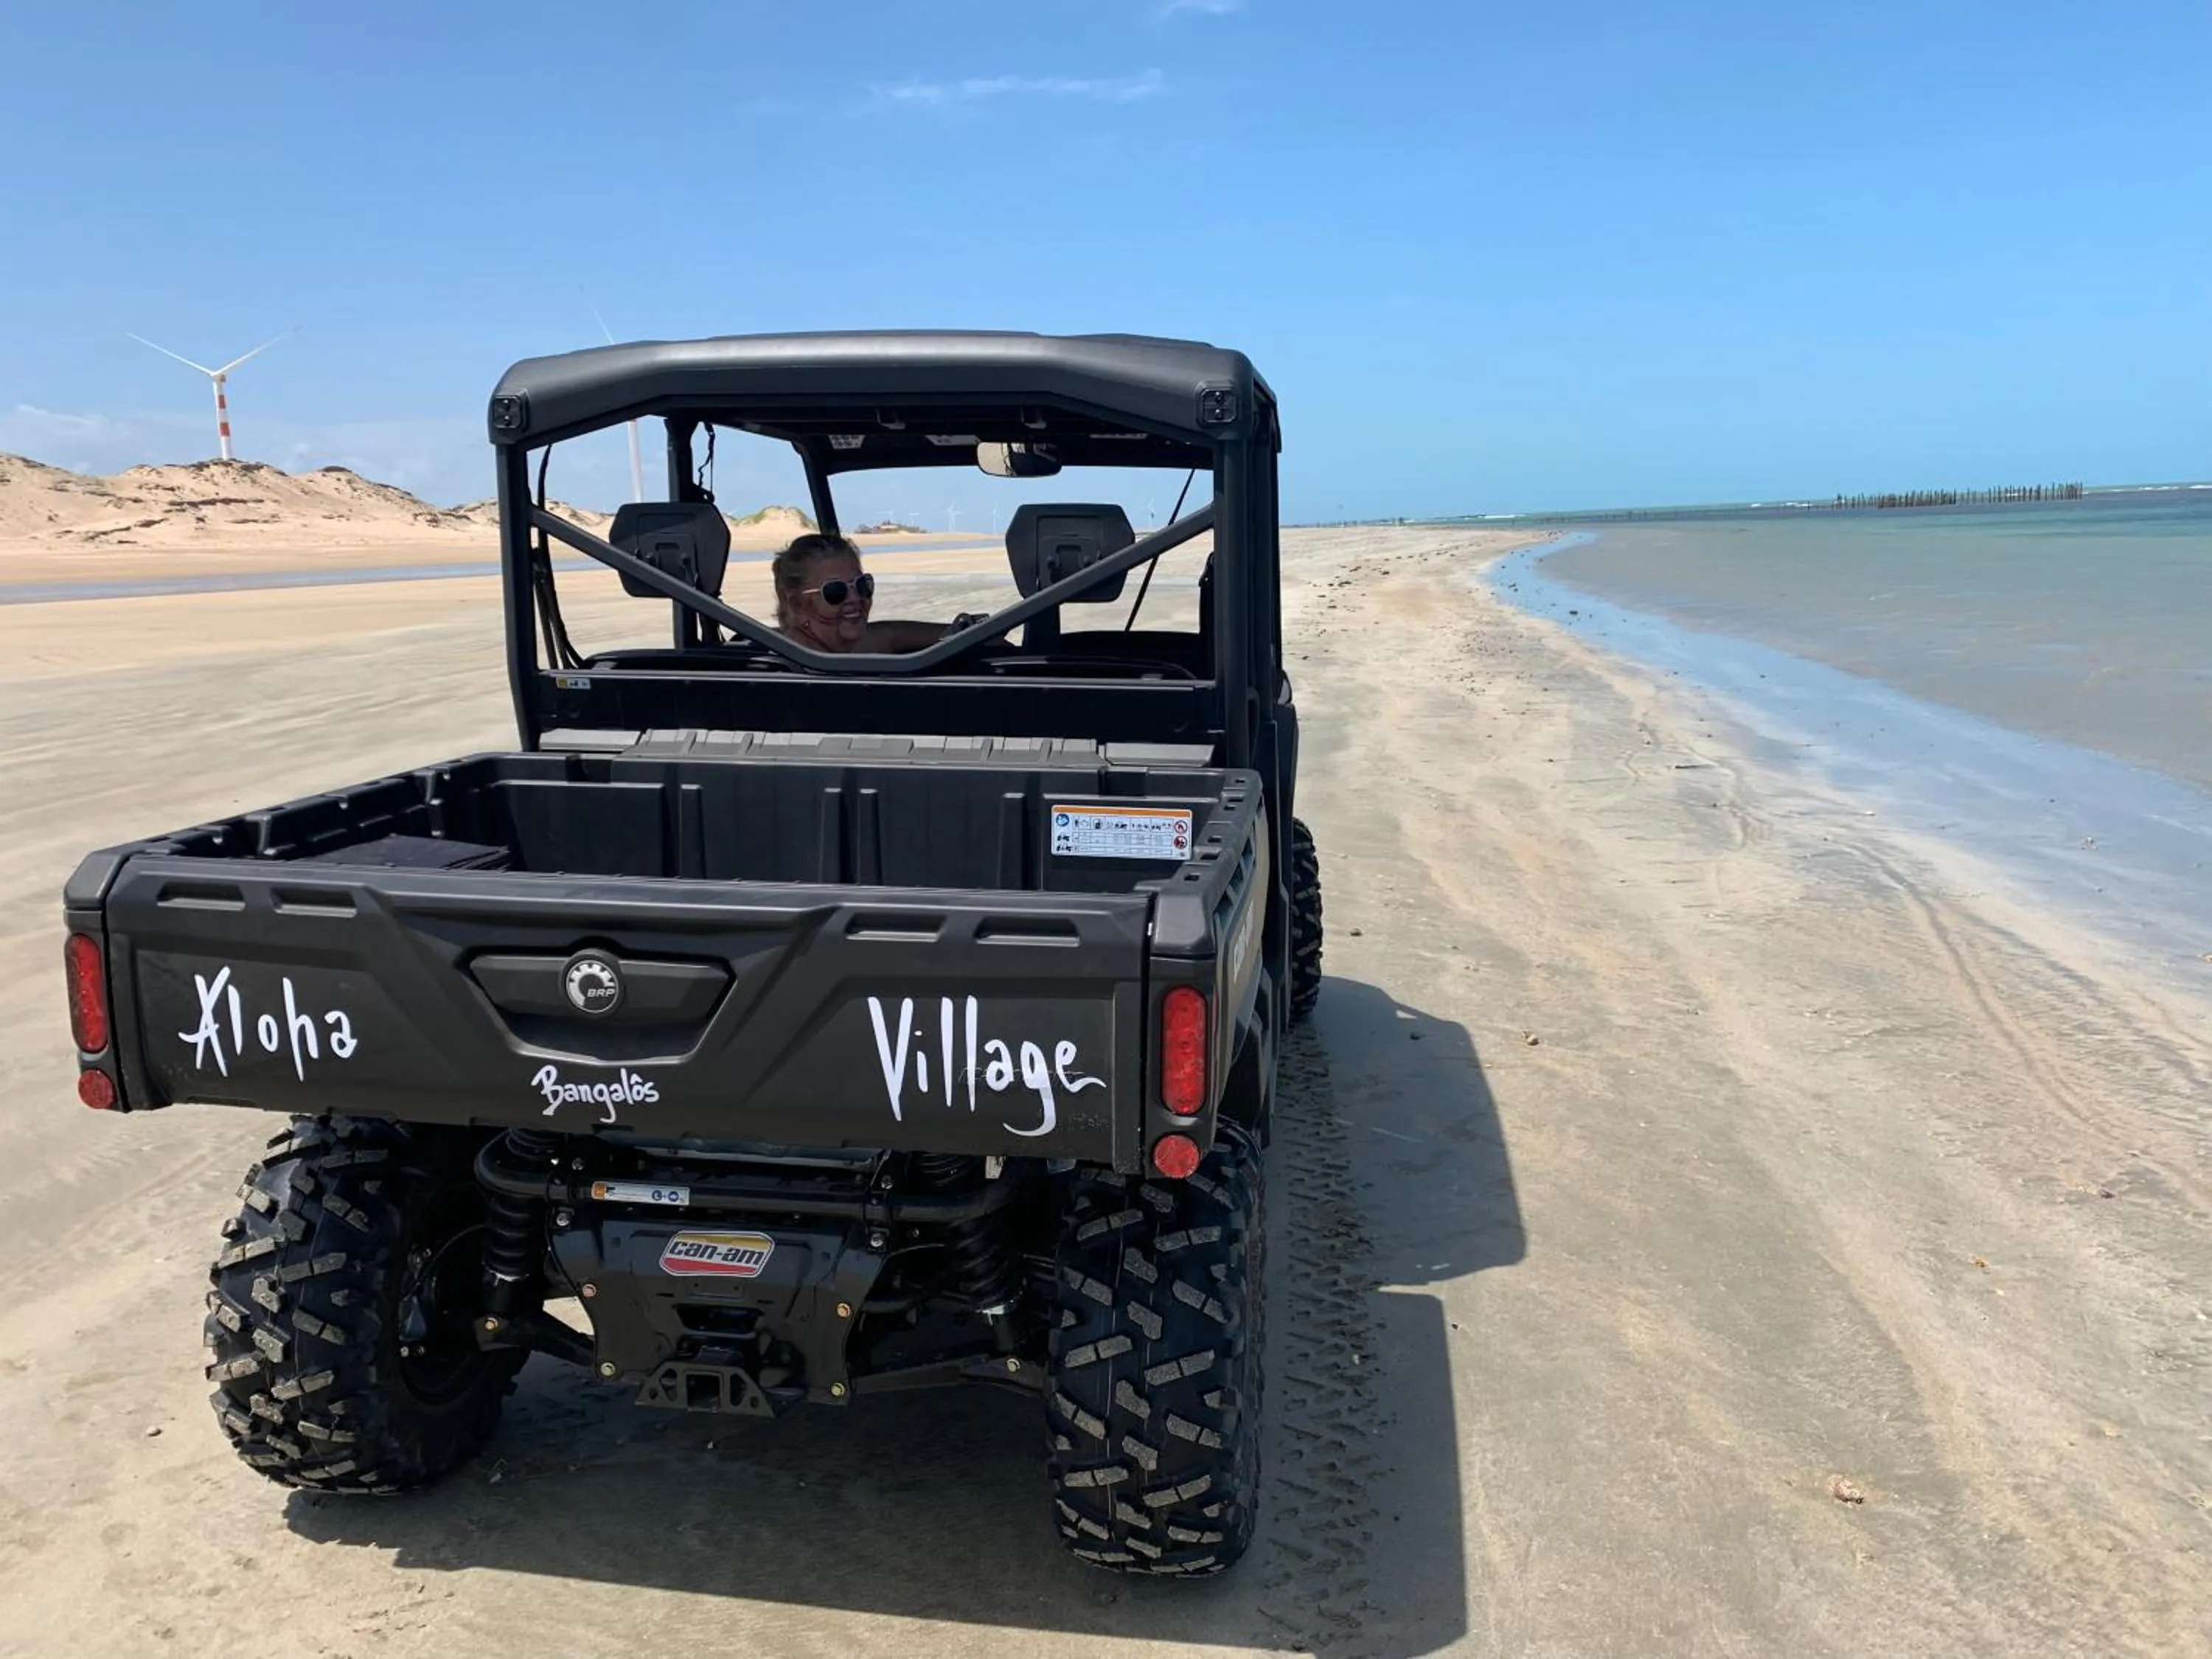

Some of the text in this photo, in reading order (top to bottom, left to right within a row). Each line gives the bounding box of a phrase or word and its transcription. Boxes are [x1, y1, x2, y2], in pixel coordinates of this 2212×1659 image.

[588, 988, 616, 998] BRP
[178, 966, 1107, 1136] Aloha Village
[531, 1065, 660, 1122] Bangalôs
[668, 1240, 765, 1265] can-am
